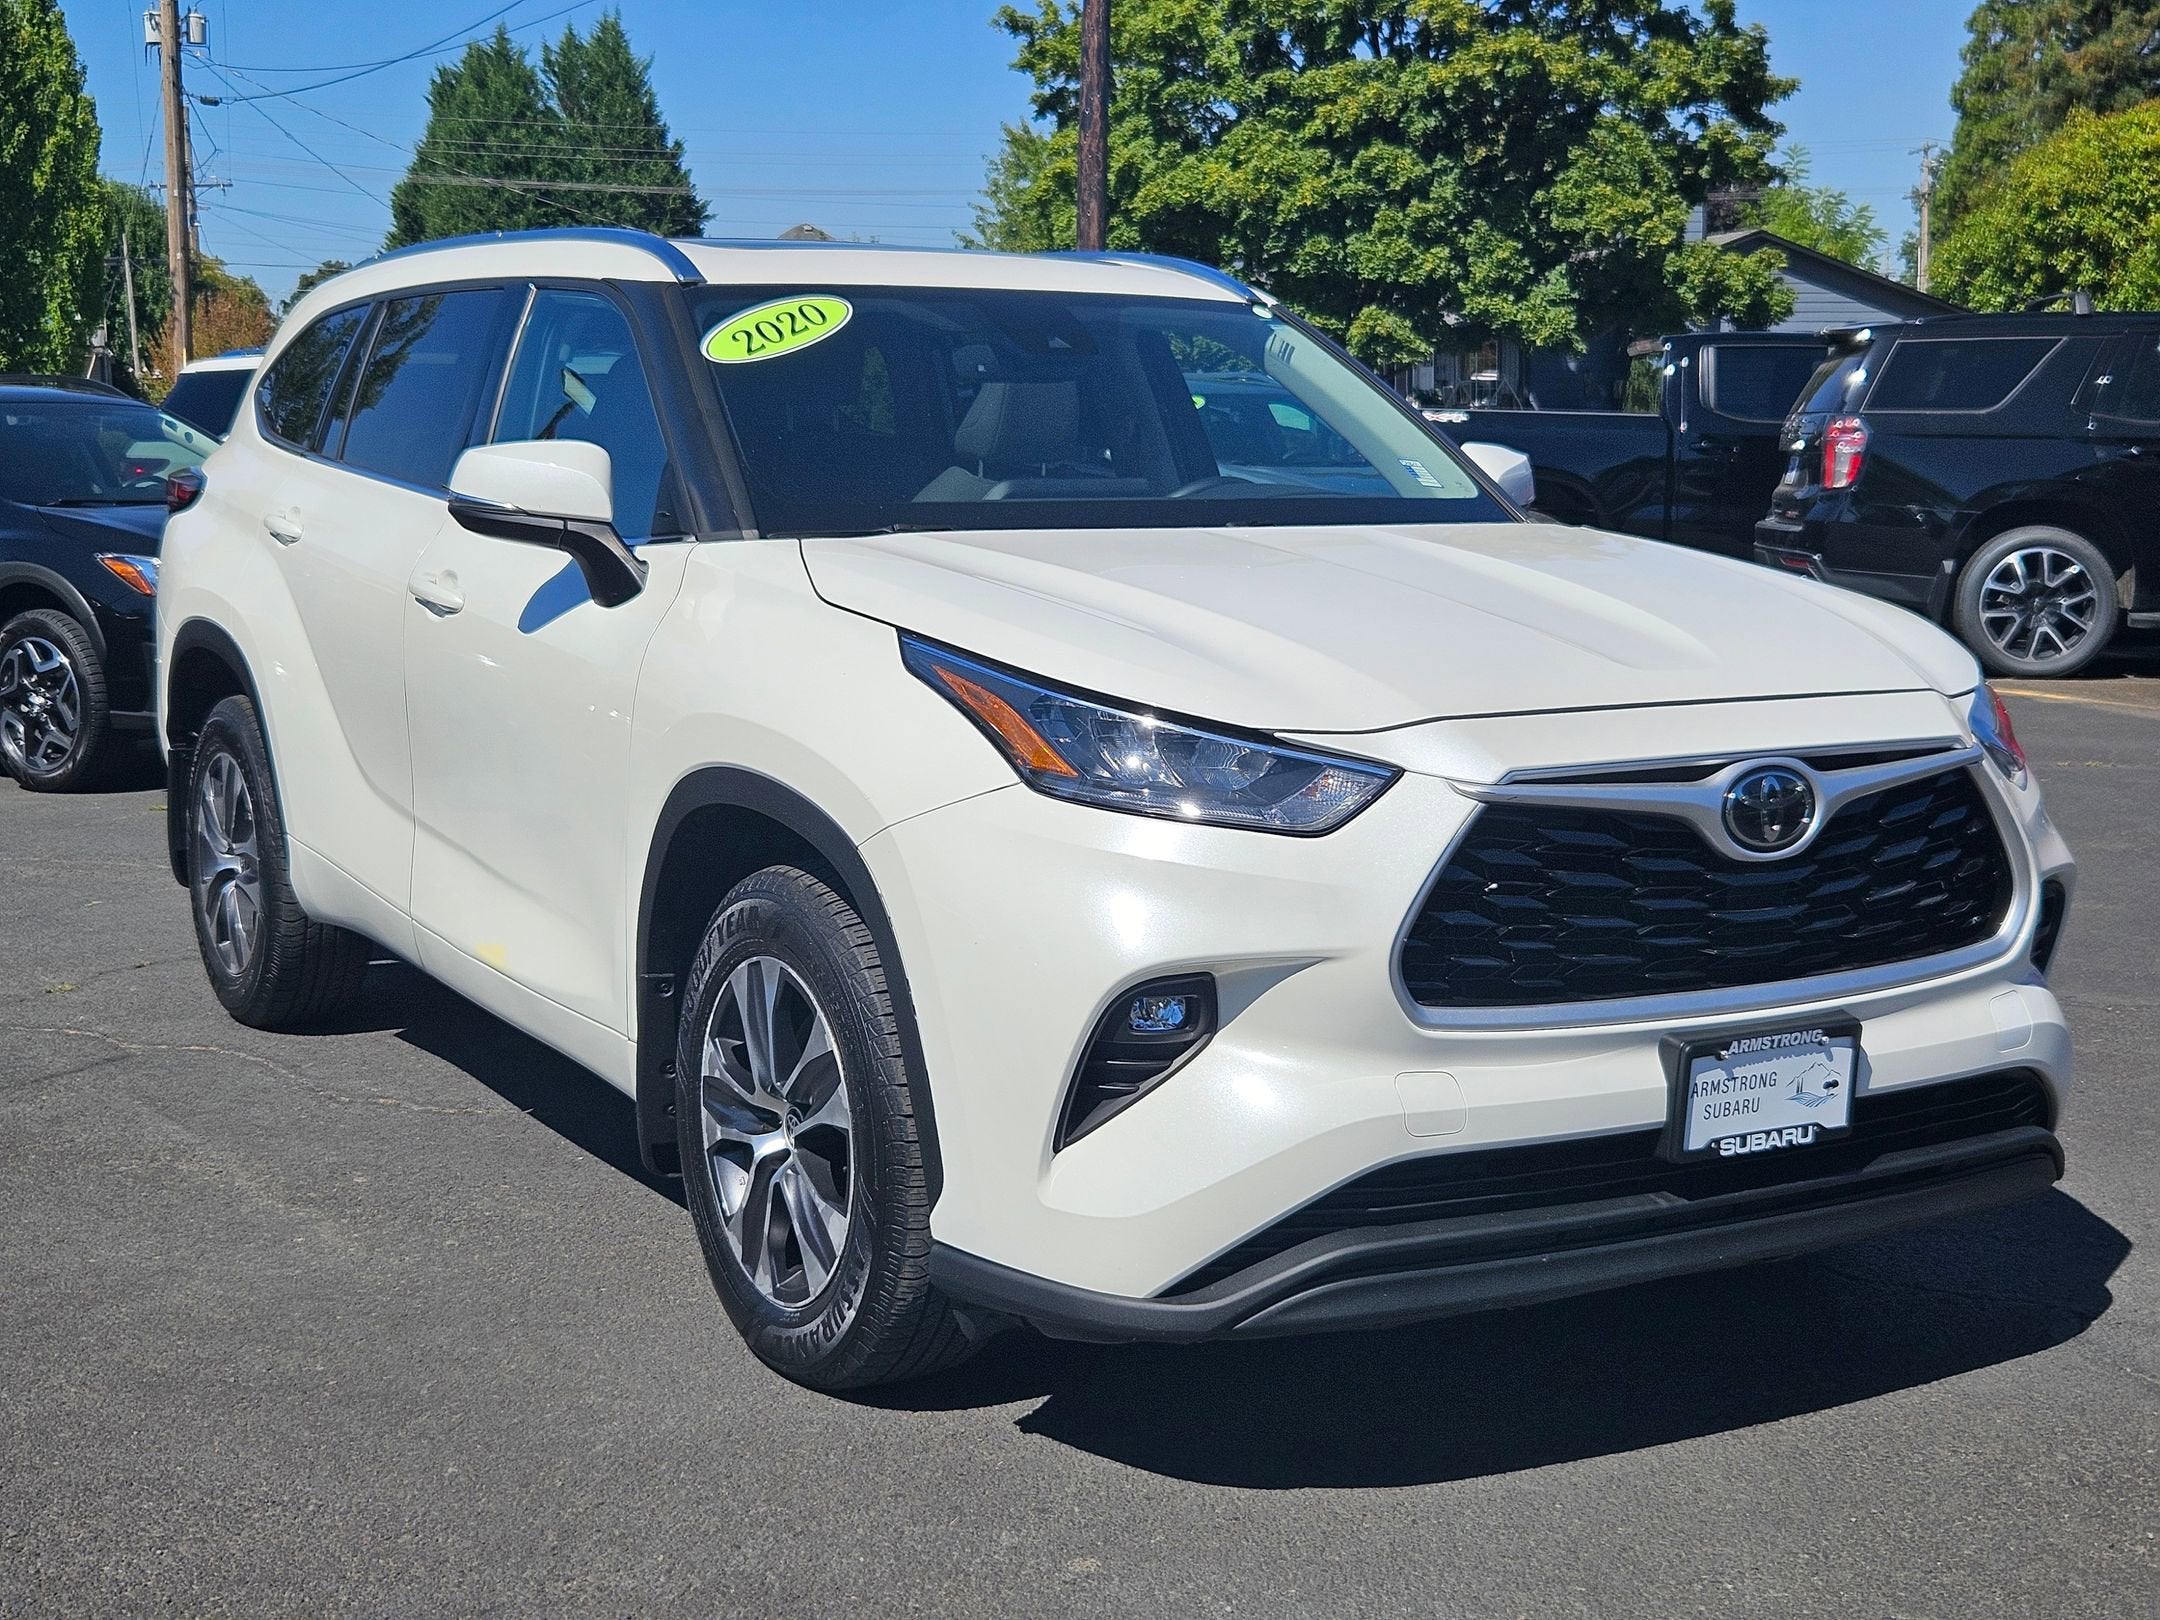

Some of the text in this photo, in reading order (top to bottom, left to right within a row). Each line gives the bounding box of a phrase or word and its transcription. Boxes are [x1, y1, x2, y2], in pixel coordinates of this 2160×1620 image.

[732, 304, 827, 356] 2020
[1728, 1028, 1824, 1054] ARMSTRONG
[1691, 1071, 1777, 1099] ARMSTRONG
[1703, 1097, 1761, 1120] SUBARU
[1719, 1125, 1815, 1157] SUBARU
